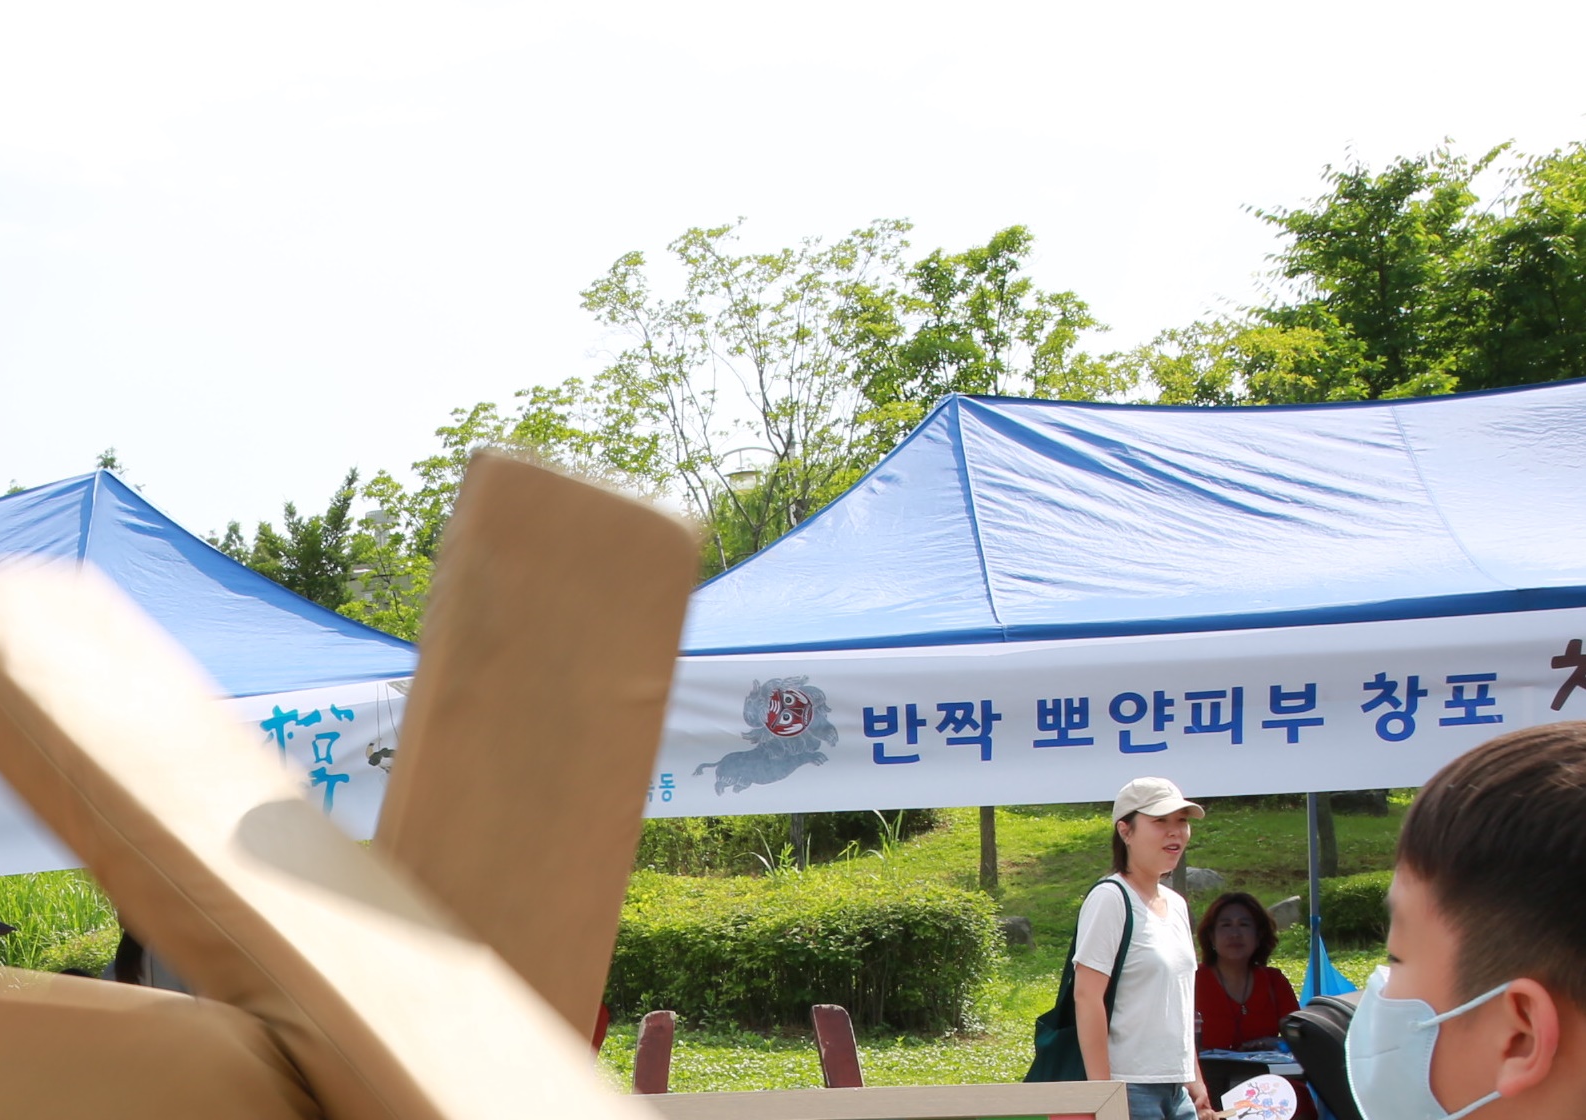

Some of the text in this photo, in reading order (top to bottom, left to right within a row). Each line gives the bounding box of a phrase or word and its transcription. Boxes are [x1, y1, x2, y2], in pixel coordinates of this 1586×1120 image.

[862, 699, 1002, 765] 반짝
[1032, 682, 1325, 754] 뽀얀피부
[1360, 671, 1504, 742] 창포
